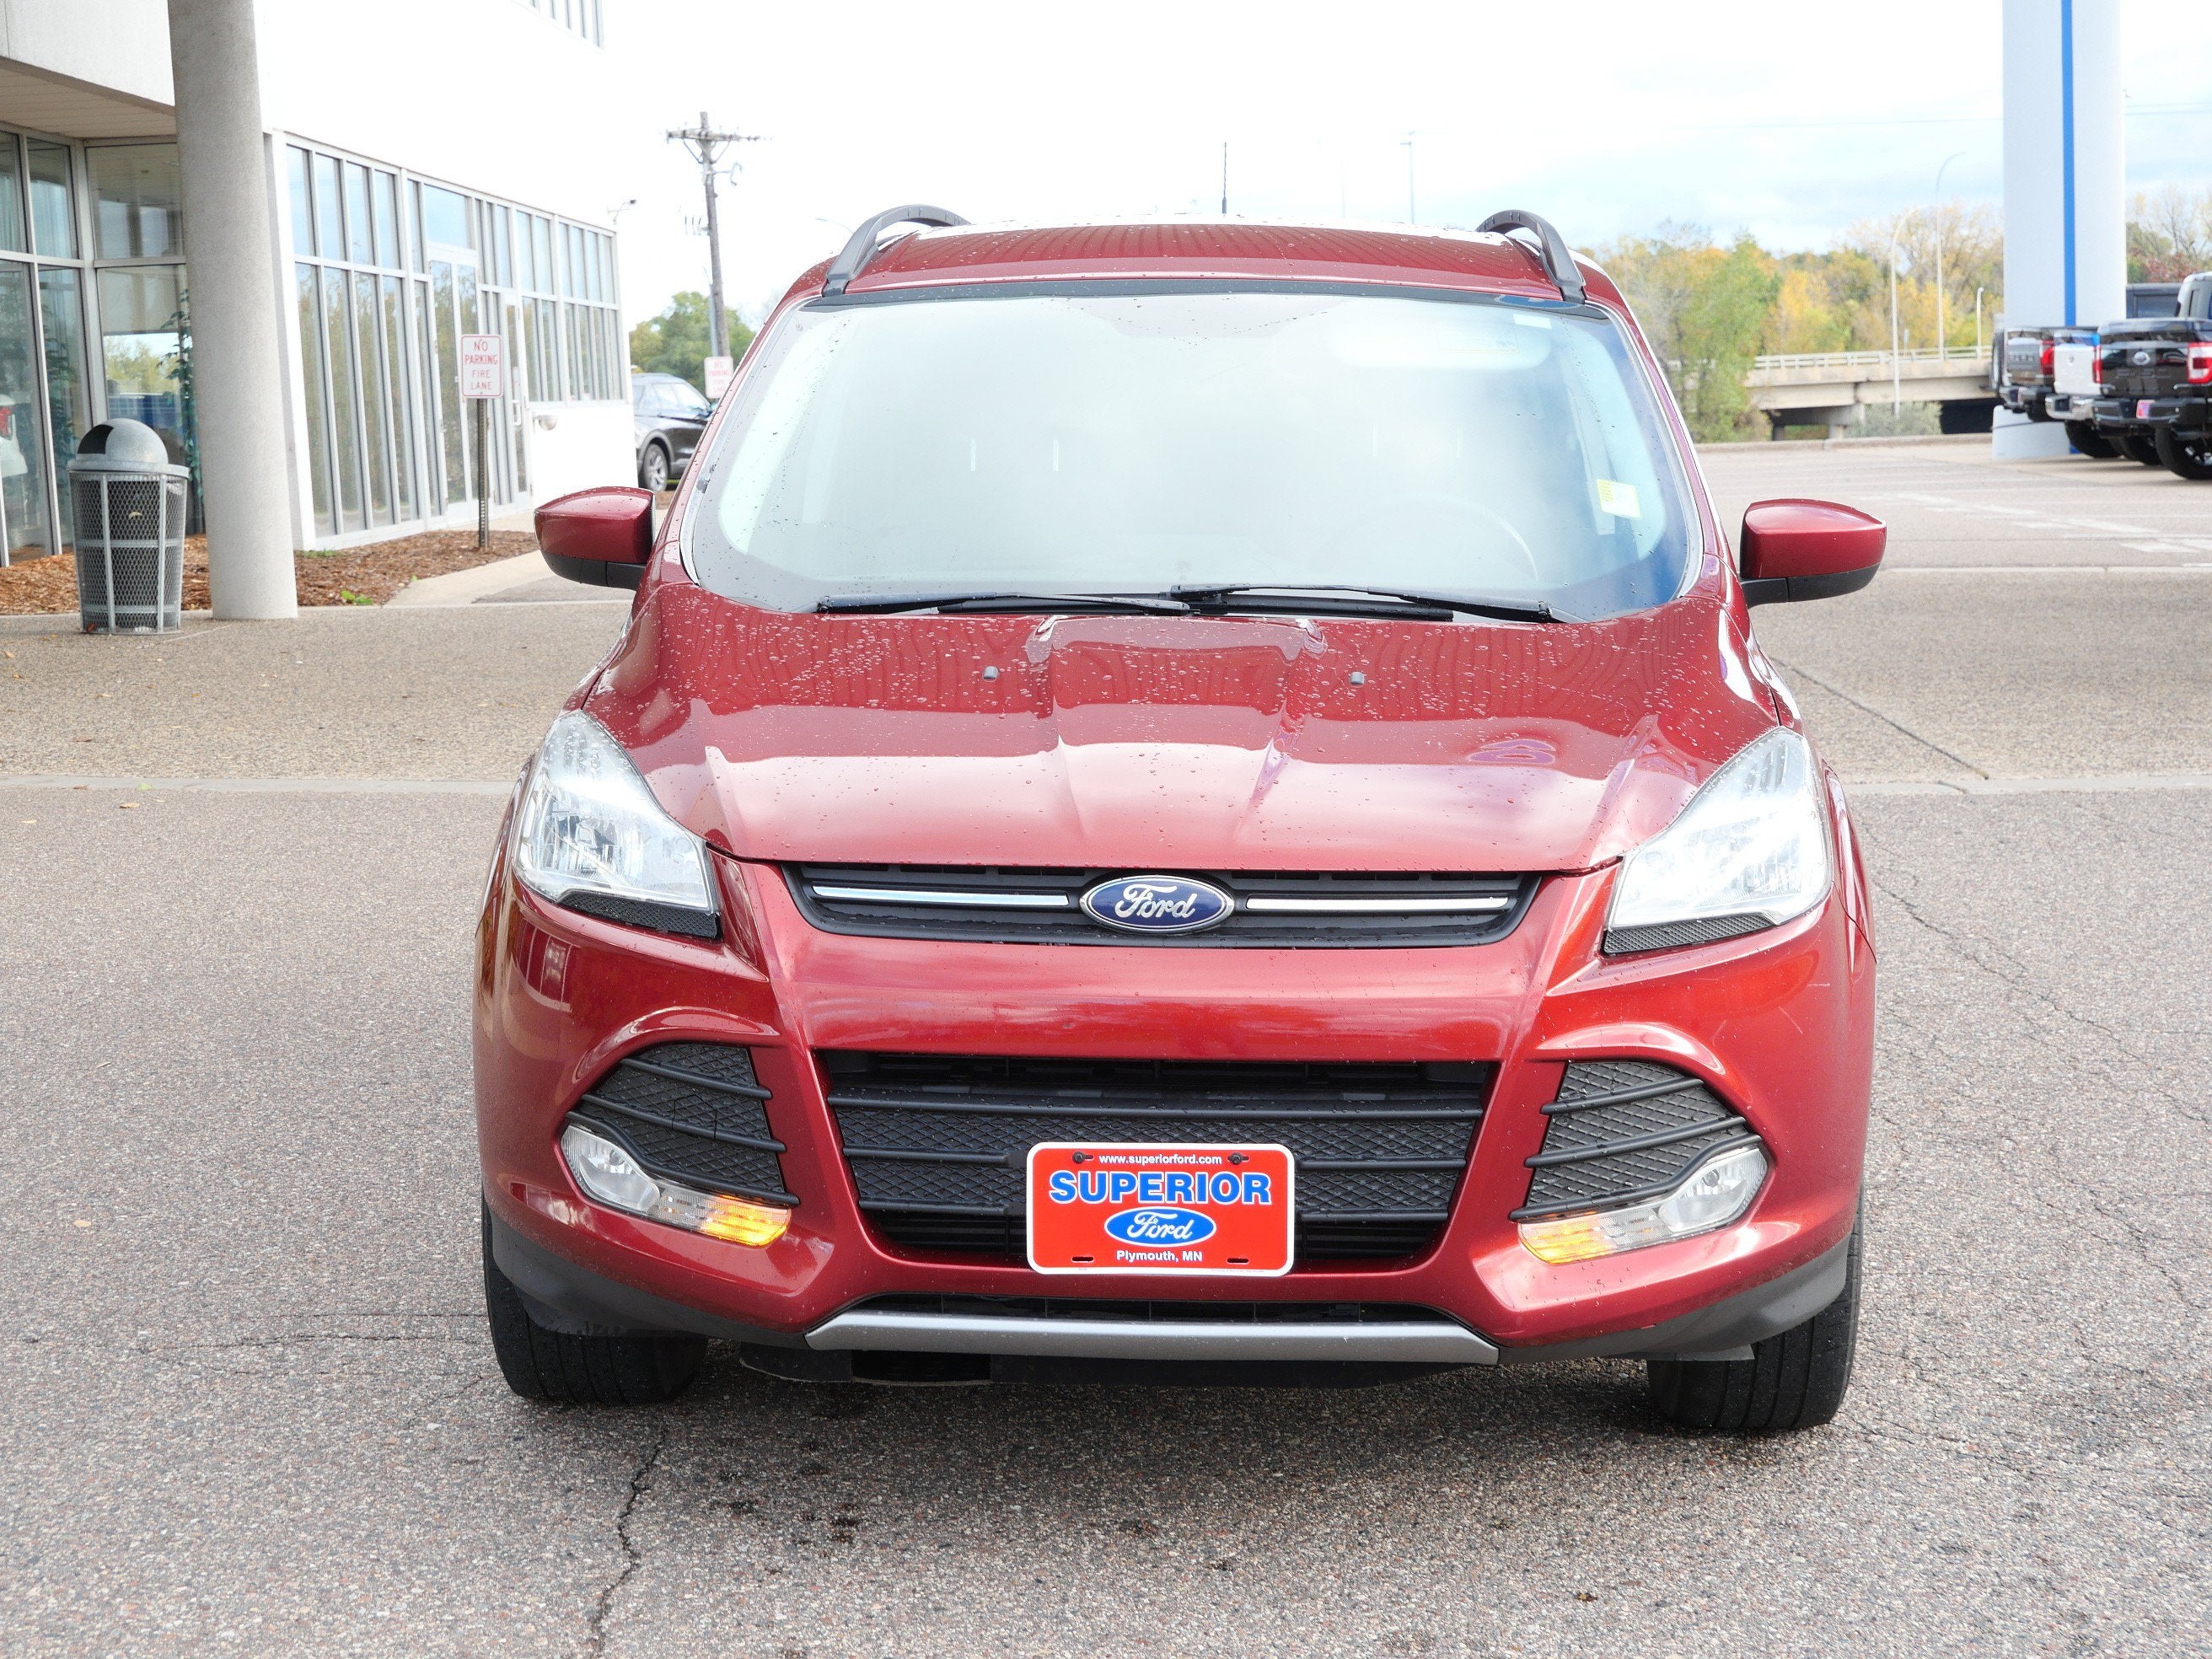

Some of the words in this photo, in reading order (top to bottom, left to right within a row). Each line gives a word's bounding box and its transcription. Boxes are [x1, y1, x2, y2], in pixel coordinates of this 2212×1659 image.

[474, 341, 488, 352] NO
[464, 354, 498, 365] PARKING
[472, 369, 491, 379] FIRE
[470, 381, 492, 390] LANE
[1114, 883, 1198, 918] Ford
[1098, 1153, 1222, 1166] www.superiorford.com
[1049, 1170, 1272, 1205] SUPERIOR
[1126, 1211, 1195, 1240] Ford
[1116, 1250, 1179, 1263] Plymouth,
[1182, 1250, 1203, 1262] MN
